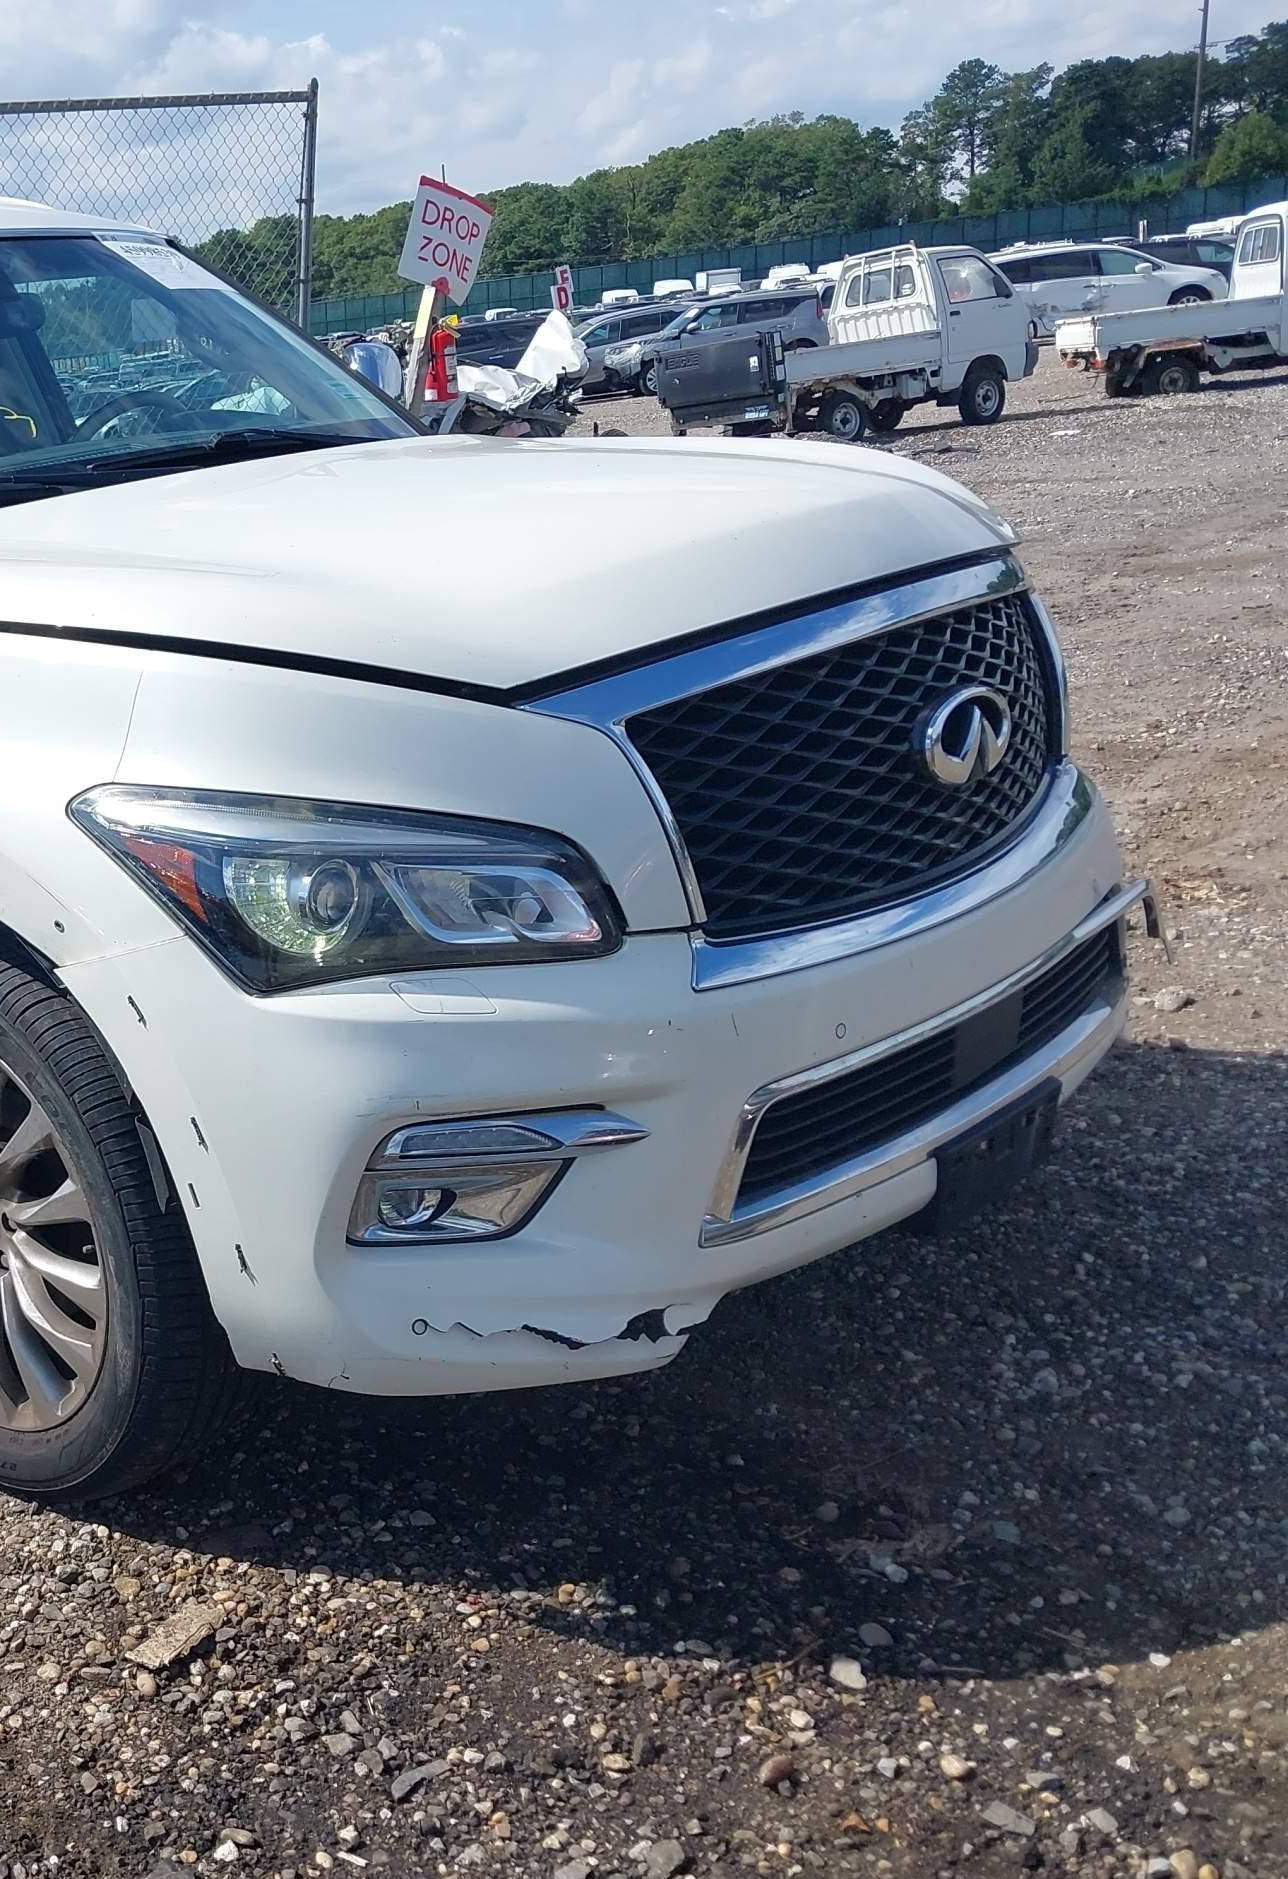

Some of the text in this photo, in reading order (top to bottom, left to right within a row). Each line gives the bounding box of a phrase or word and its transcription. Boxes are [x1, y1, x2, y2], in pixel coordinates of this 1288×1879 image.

[421, 199, 481, 246] DROP
[417, 235, 473, 284] ZONE
[556, 285, 570, 310] D
